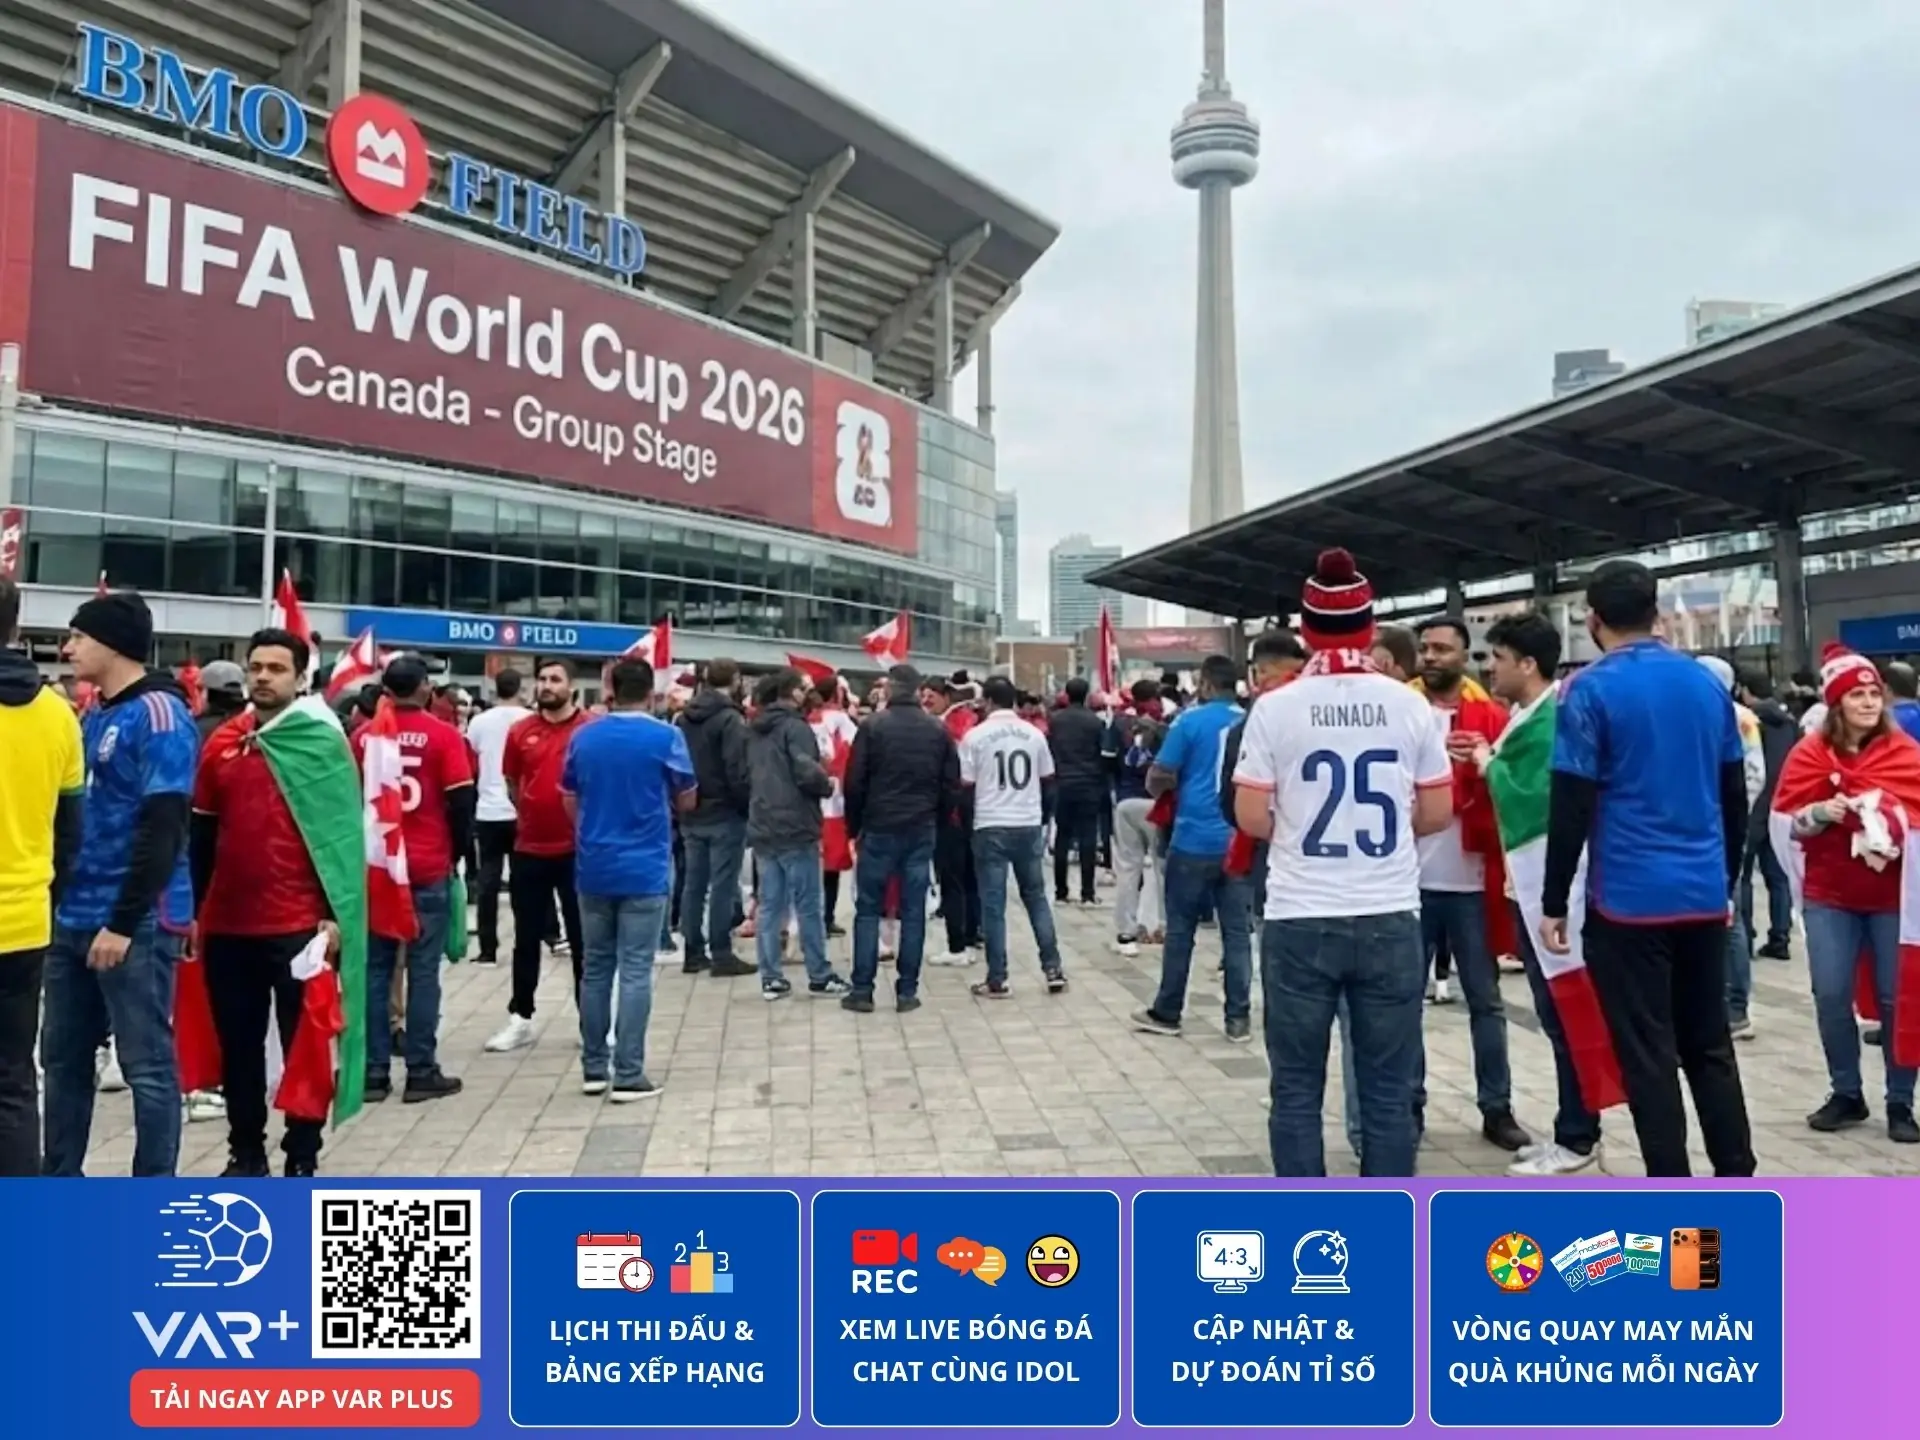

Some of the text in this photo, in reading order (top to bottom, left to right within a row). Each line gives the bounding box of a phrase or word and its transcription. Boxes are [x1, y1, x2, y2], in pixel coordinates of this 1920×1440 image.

[72, 21, 646, 274] BMO FIELD
[70, 173, 804, 446] FIFA World Cup 2026
[287, 347, 469, 425] Canada
[514, 396, 624, 465] Group
[633, 423, 716, 483] Stage
[449, 620, 495, 641] BMO
[994, 748, 1031, 790] 10
[1302, 749, 1399, 858] 25
